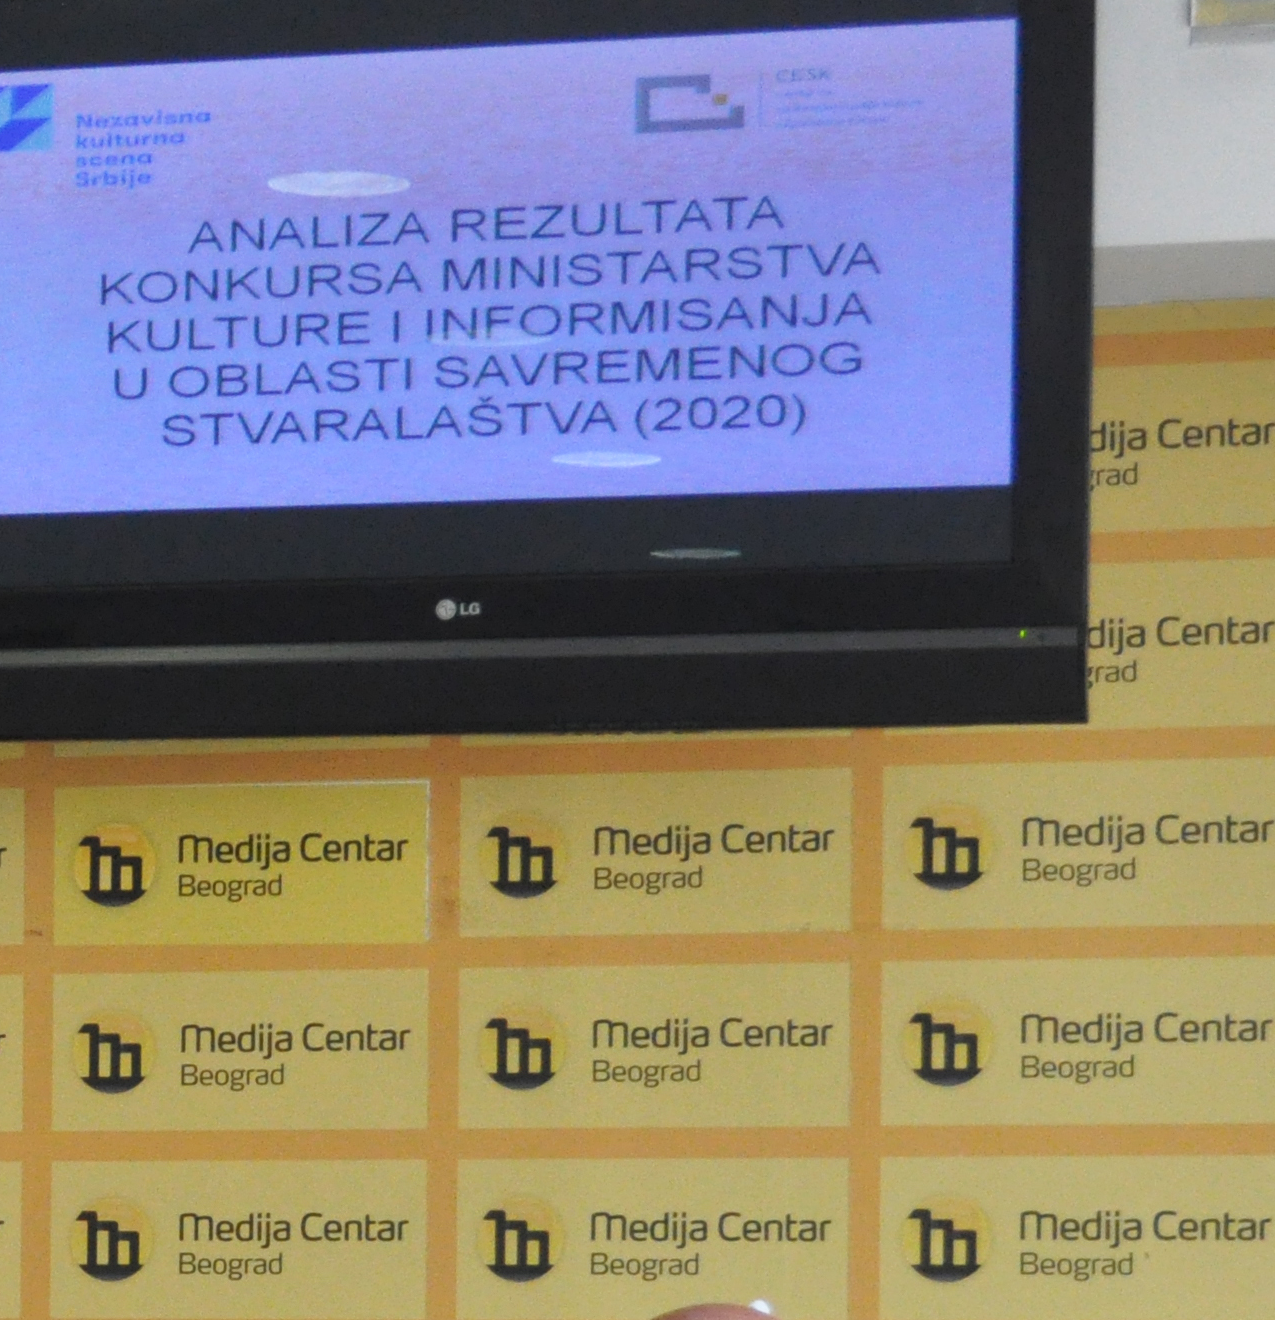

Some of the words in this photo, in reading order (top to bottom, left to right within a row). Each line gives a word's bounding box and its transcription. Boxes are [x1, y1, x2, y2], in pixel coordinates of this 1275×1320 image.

[74, 108, 213, 130] Nezavisna
[73, 132, 187, 151] kulturna
[74, 152, 154, 169] scena
[74, 169, 154, 191] Srbije
[189, 212, 429, 253] ANALIZA
[451, 196, 785, 242] REZULTATA
[100, 261, 422, 306] KONKURSA
[443, 242, 881, 291] MINISTARSTVA
[107, 311, 369, 354] KULTURE
[426, 292, 872, 338] INFORMISANJA
[114, 368, 148, 400] U
[168, 358, 412, 398] OBLASTI
[435, 341, 863, 389] SAVREMENOG
[163, 399, 617, 447] STVARALAŠTVA
[634, 394, 807, 439] (2020)
[459, 602, 481, 616] LG
[1021, 815, 1146, 854] Medija
[1154, 813, 1275, 846] Centar
[178, 833, 291, 871] Medija
[299, 832, 409, 863] Centar
[178, 874, 283, 903] Beograd
[1022, 857, 1137, 887] Beograd
[592, 1017, 711, 1056] Medija
[719, 1017, 834, 1049] Centar
[592, 1059, 702, 1088] Beograd
[178, 1212, 292, 1250] Medija
[299, 1211, 409, 1243] Centar
[1019, 1210, 1143, 1250] Medija
[1152, 1209, 1272, 1242] Centar
[178, 1251, 283, 1281] Beograd
[1019, 1251, 1134, 1282] Beograd
